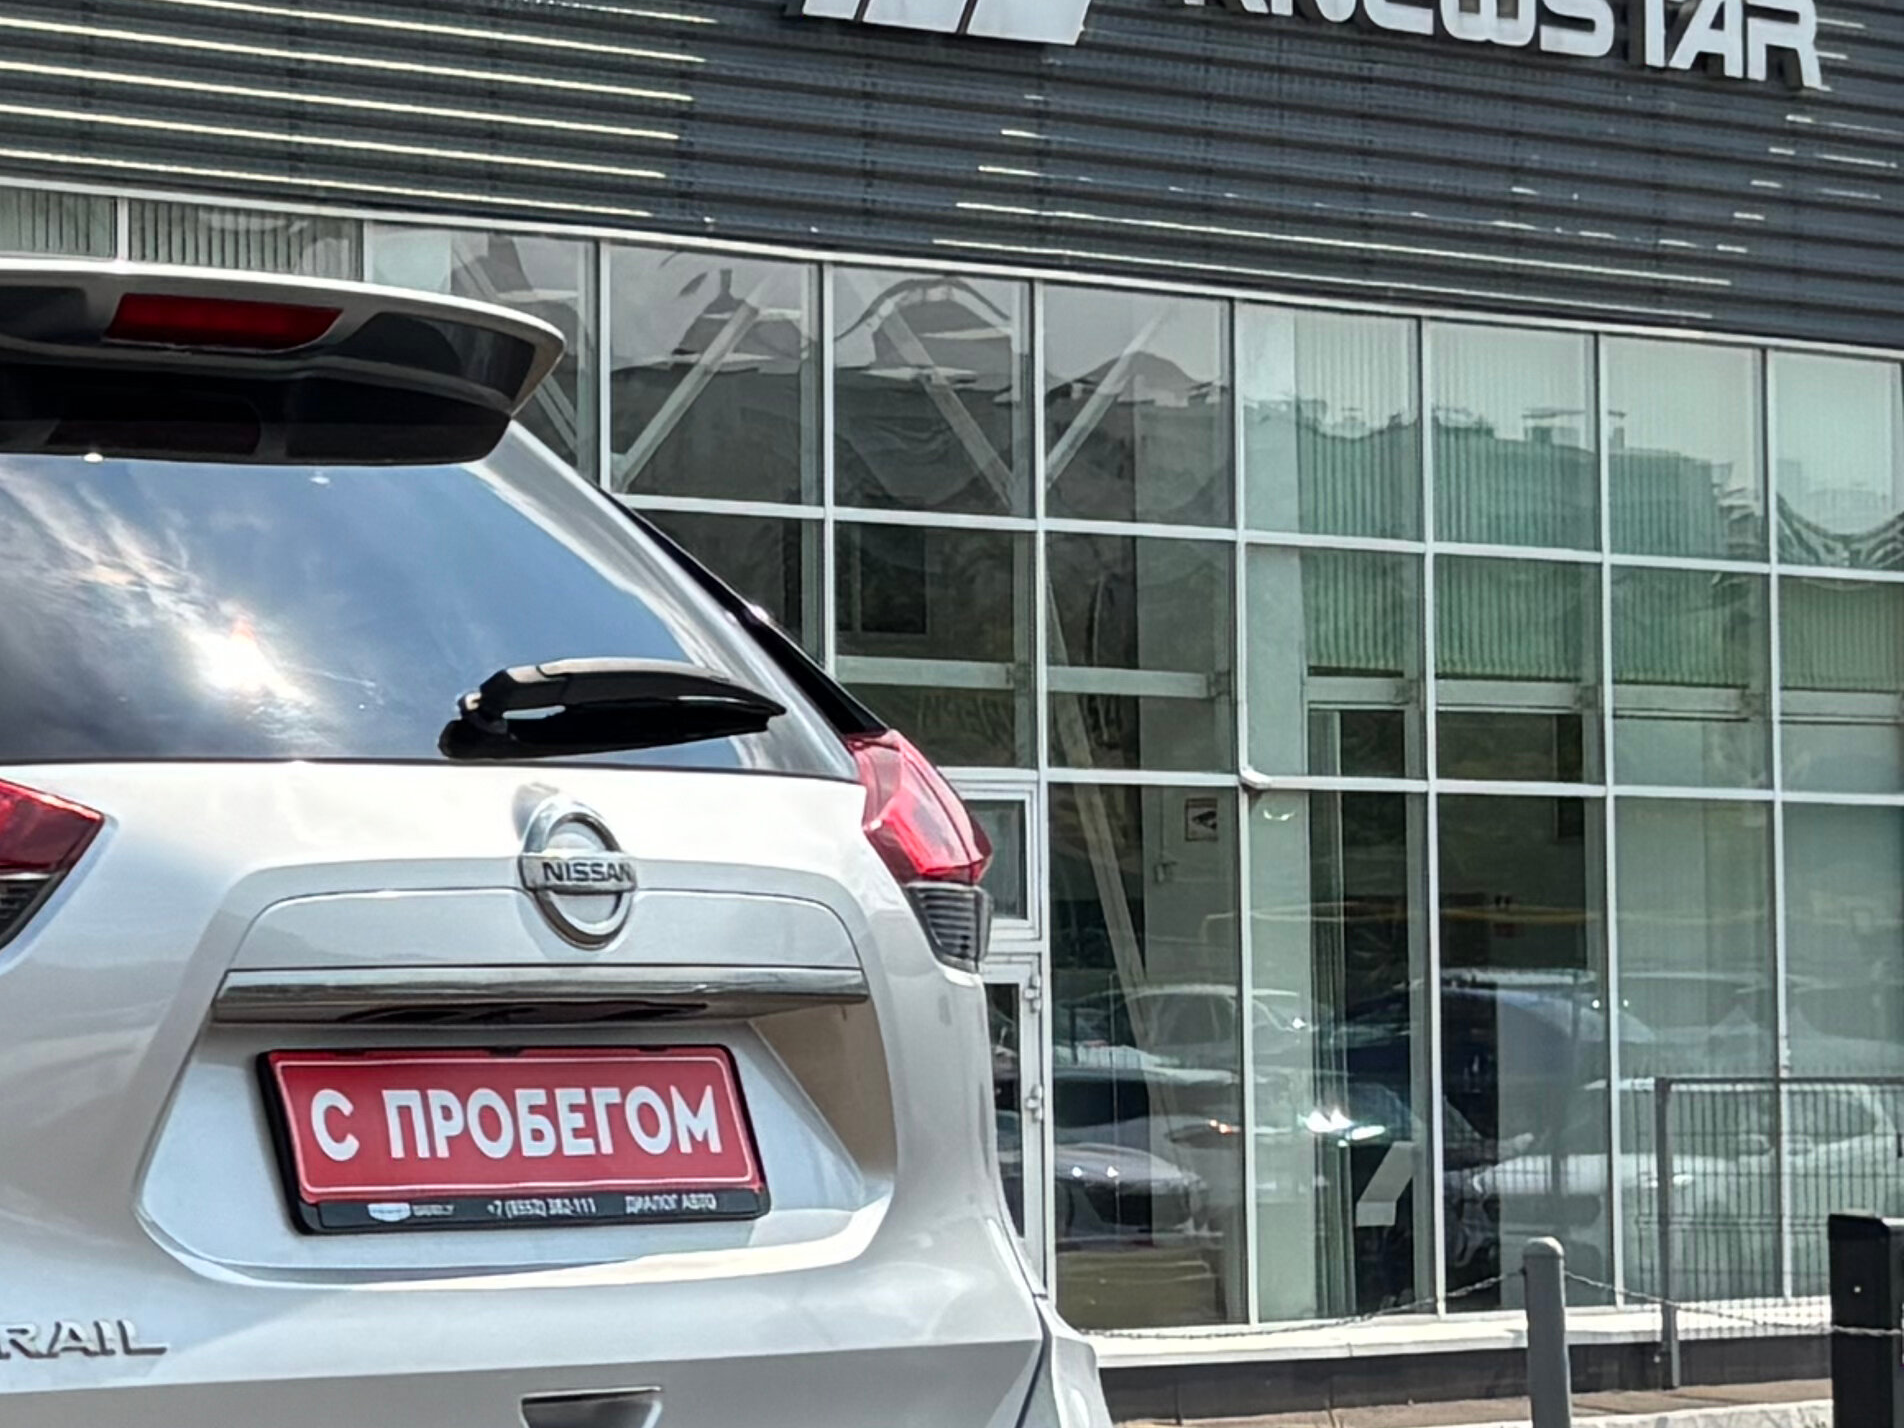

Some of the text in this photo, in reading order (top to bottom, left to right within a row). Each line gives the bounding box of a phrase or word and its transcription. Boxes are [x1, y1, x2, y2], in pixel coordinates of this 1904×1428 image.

[542, 861, 633, 883] NISSAN
[310, 1084, 723, 1163] С ПРОБЕГОМ
